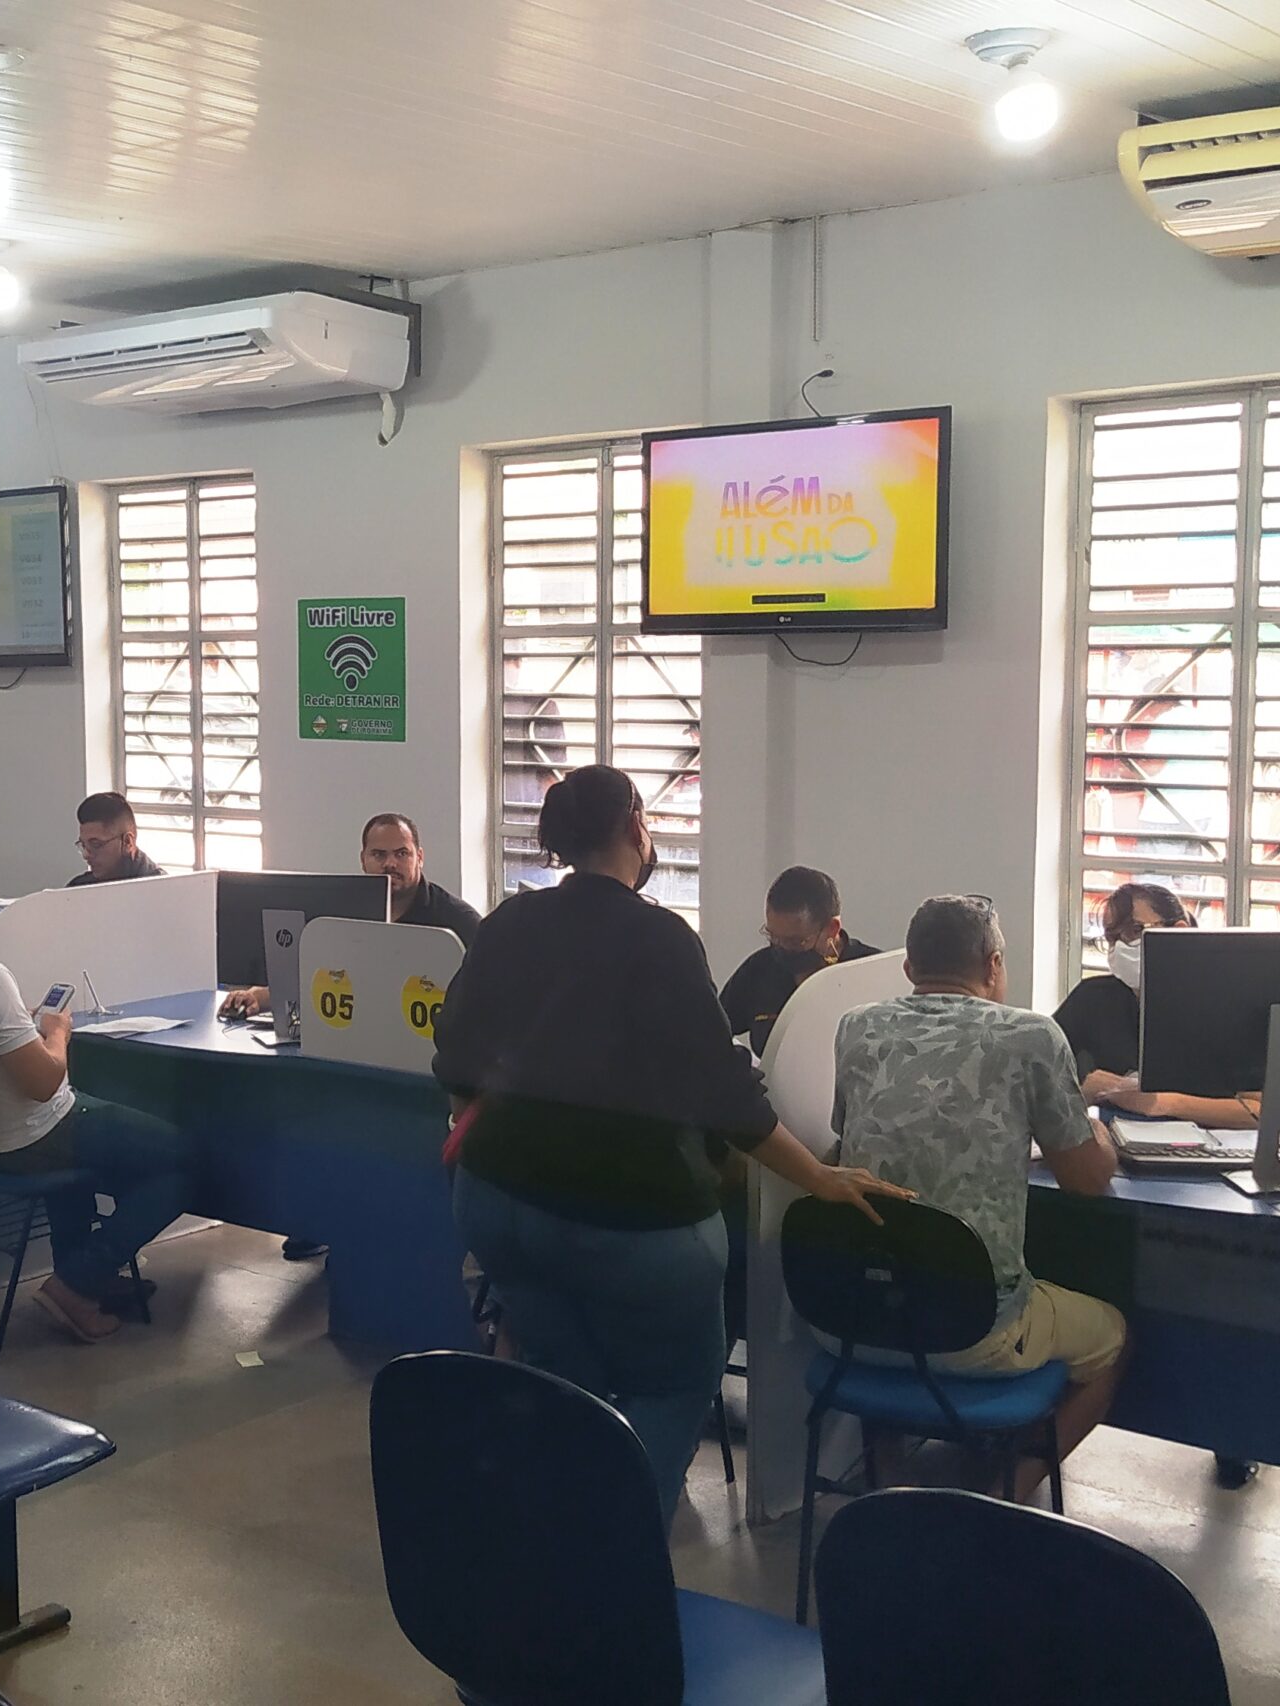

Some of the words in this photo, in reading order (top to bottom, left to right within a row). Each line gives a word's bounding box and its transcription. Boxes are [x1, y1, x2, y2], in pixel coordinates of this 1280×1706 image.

[307, 606, 347, 627] WiFi
[349, 606, 396, 627] Livre
[336, 695, 381, 708] DETRAN
[383, 695, 400, 708] RR
[351, 719, 393, 728] GOVERNO
[276, 928, 294, 948] hp
[320, 991, 354, 1021] 05
